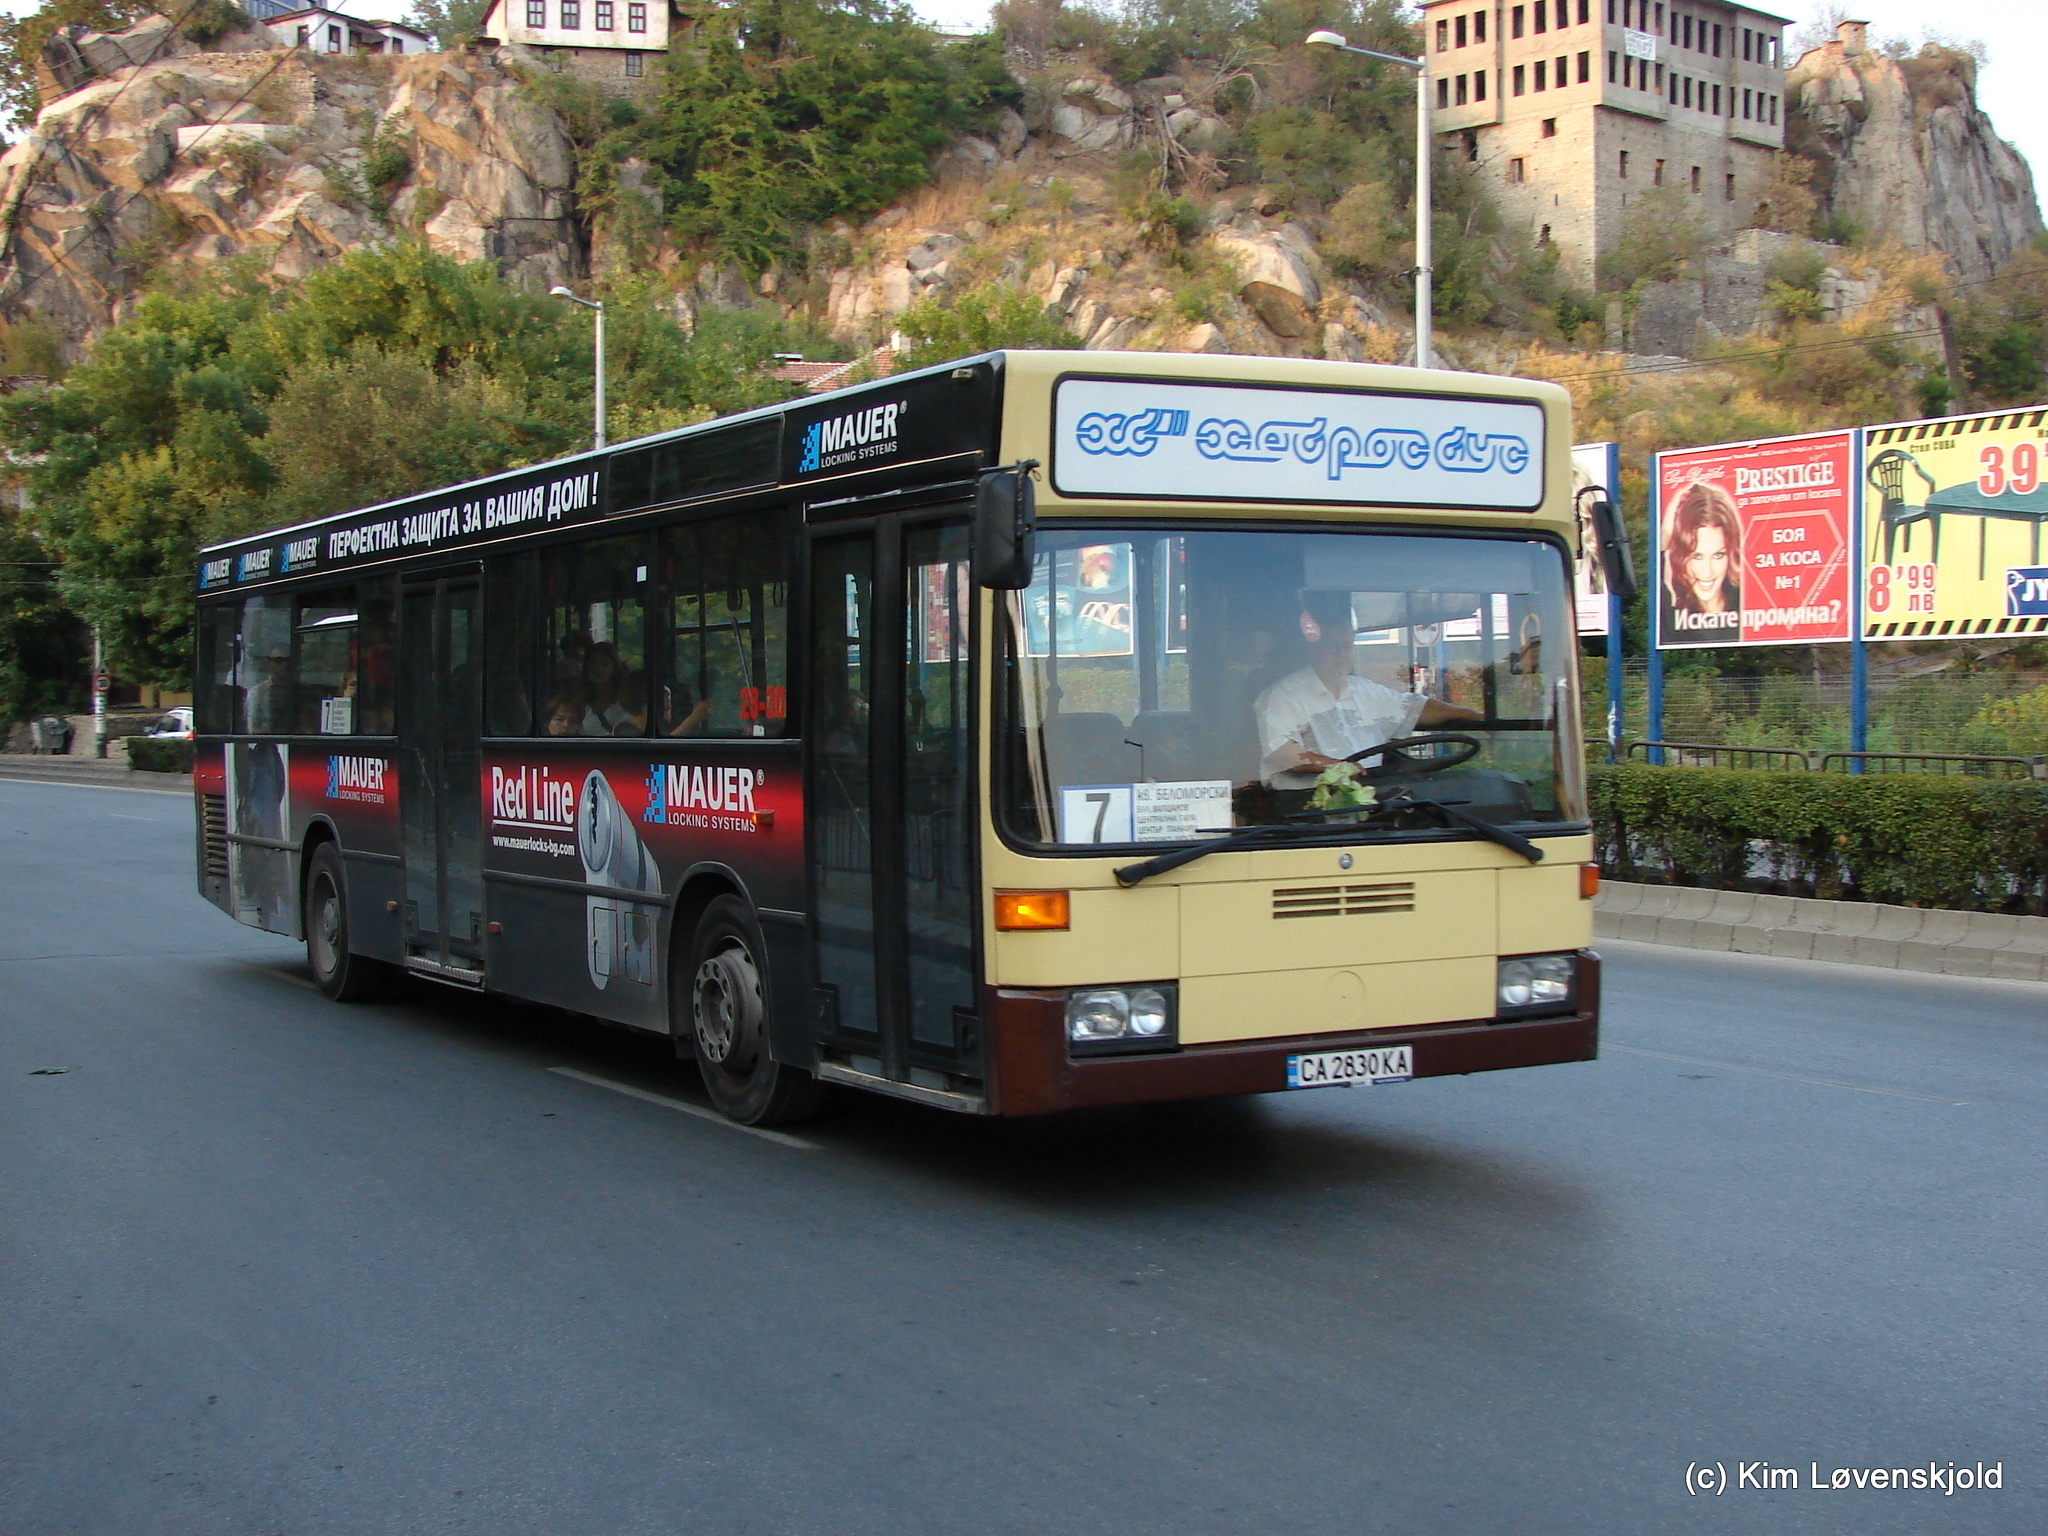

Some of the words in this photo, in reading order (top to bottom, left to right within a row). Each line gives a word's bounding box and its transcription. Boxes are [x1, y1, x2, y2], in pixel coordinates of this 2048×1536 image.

[820, 450, 857, 468] LOCKING
[858, 440, 898, 460] SYSTEMS
[1734, 461, 1835, 496] PRESTIGE
[328, 520, 399, 560] ПЕРФЕКТНА
[401, 506, 459, 547] ЗАЩИТА
[462, 501, 482, 534] ЗА
[485, 485, 545, 529] ВАШИЯ
[1772, 528, 1805, 544] БОЯ
[1755, 553, 1776, 568] ЗА
[1779, 550, 1822, 566] КОСА
[1674, 608, 1739, 631] Искате
[1742, 599, 1842, 632] промяна?
[492, 766, 526, 817] Red
[532, 766, 574, 824] Line
[1156, 786, 1229, 801] БЕЛОМОРСКИ
[668, 812, 709, 829] LOCKING
[711, 816, 757, 833] SYSTEMS
[1085, 793, 1111, 843] 7
[492, 834, 576, 858] www.mauerlocks-bg.com
